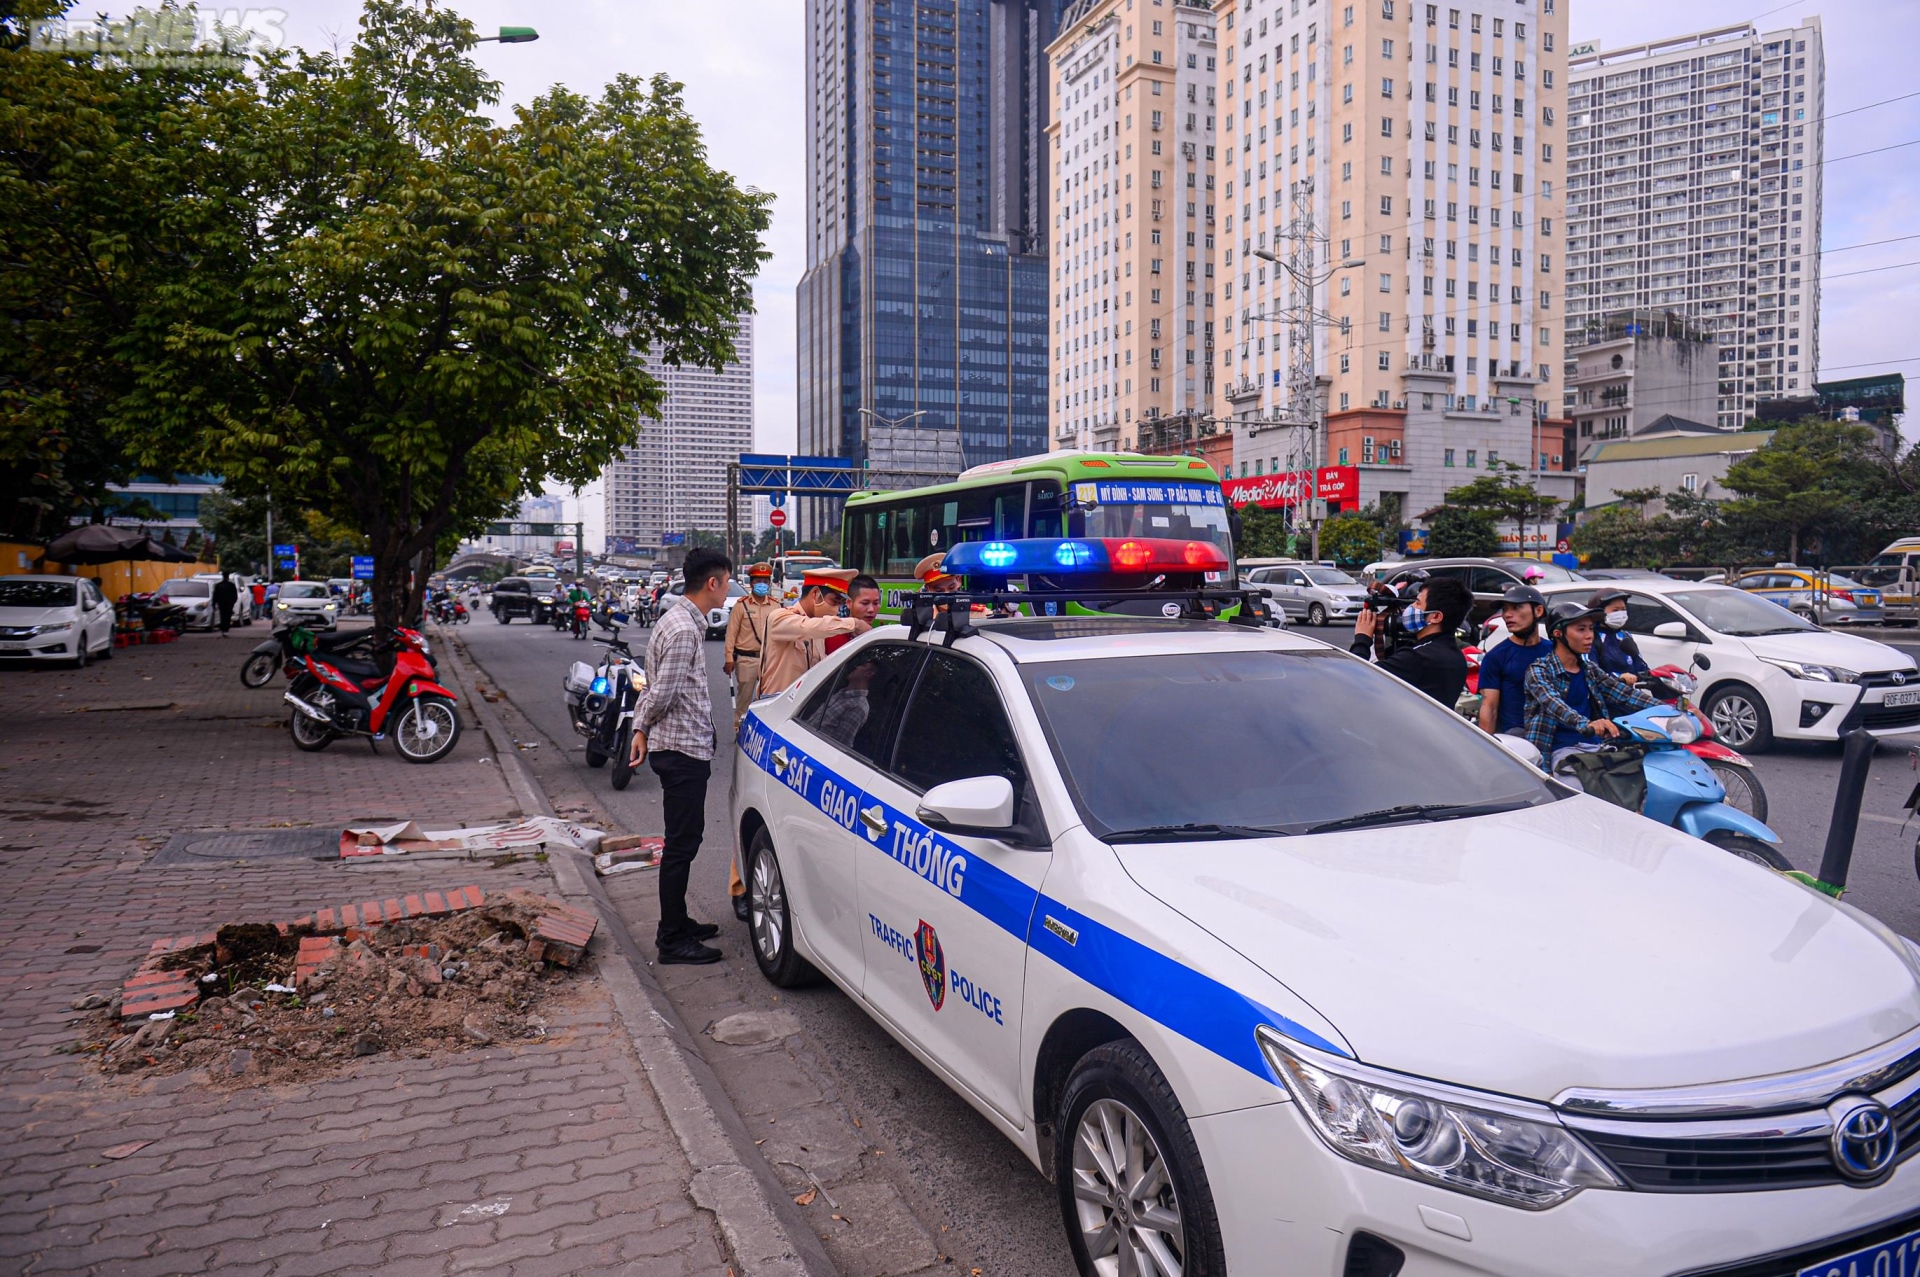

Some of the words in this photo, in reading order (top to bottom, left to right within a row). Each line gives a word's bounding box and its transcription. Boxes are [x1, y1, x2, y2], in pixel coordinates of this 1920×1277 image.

[1568, 45, 1595, 58] AZA
[1037, 492, 1054, 500] SAMCO
[1078, 486, 1096, 501] 212
[1100, 485, 1112, 501] MỸ
[1112, 485, 1128, 501] ĐÌNH
[1132, 487, 1147, 501] SAM
[1147, 487, 1164, 501] SUNG
[1167, 488, 1175, 501] TP
[1188, 488, 1202, 502] NINH
[1230, 485, 1265, 503] Media
[787, 756, 813, 797] SÁT
[820, 779, 857, 830] GIAO
[892, 820, 967, 897] THÔNG
[868, 912, 914, 962] TRAFFIC
[950, 969, 1004, 1026] POLICE
